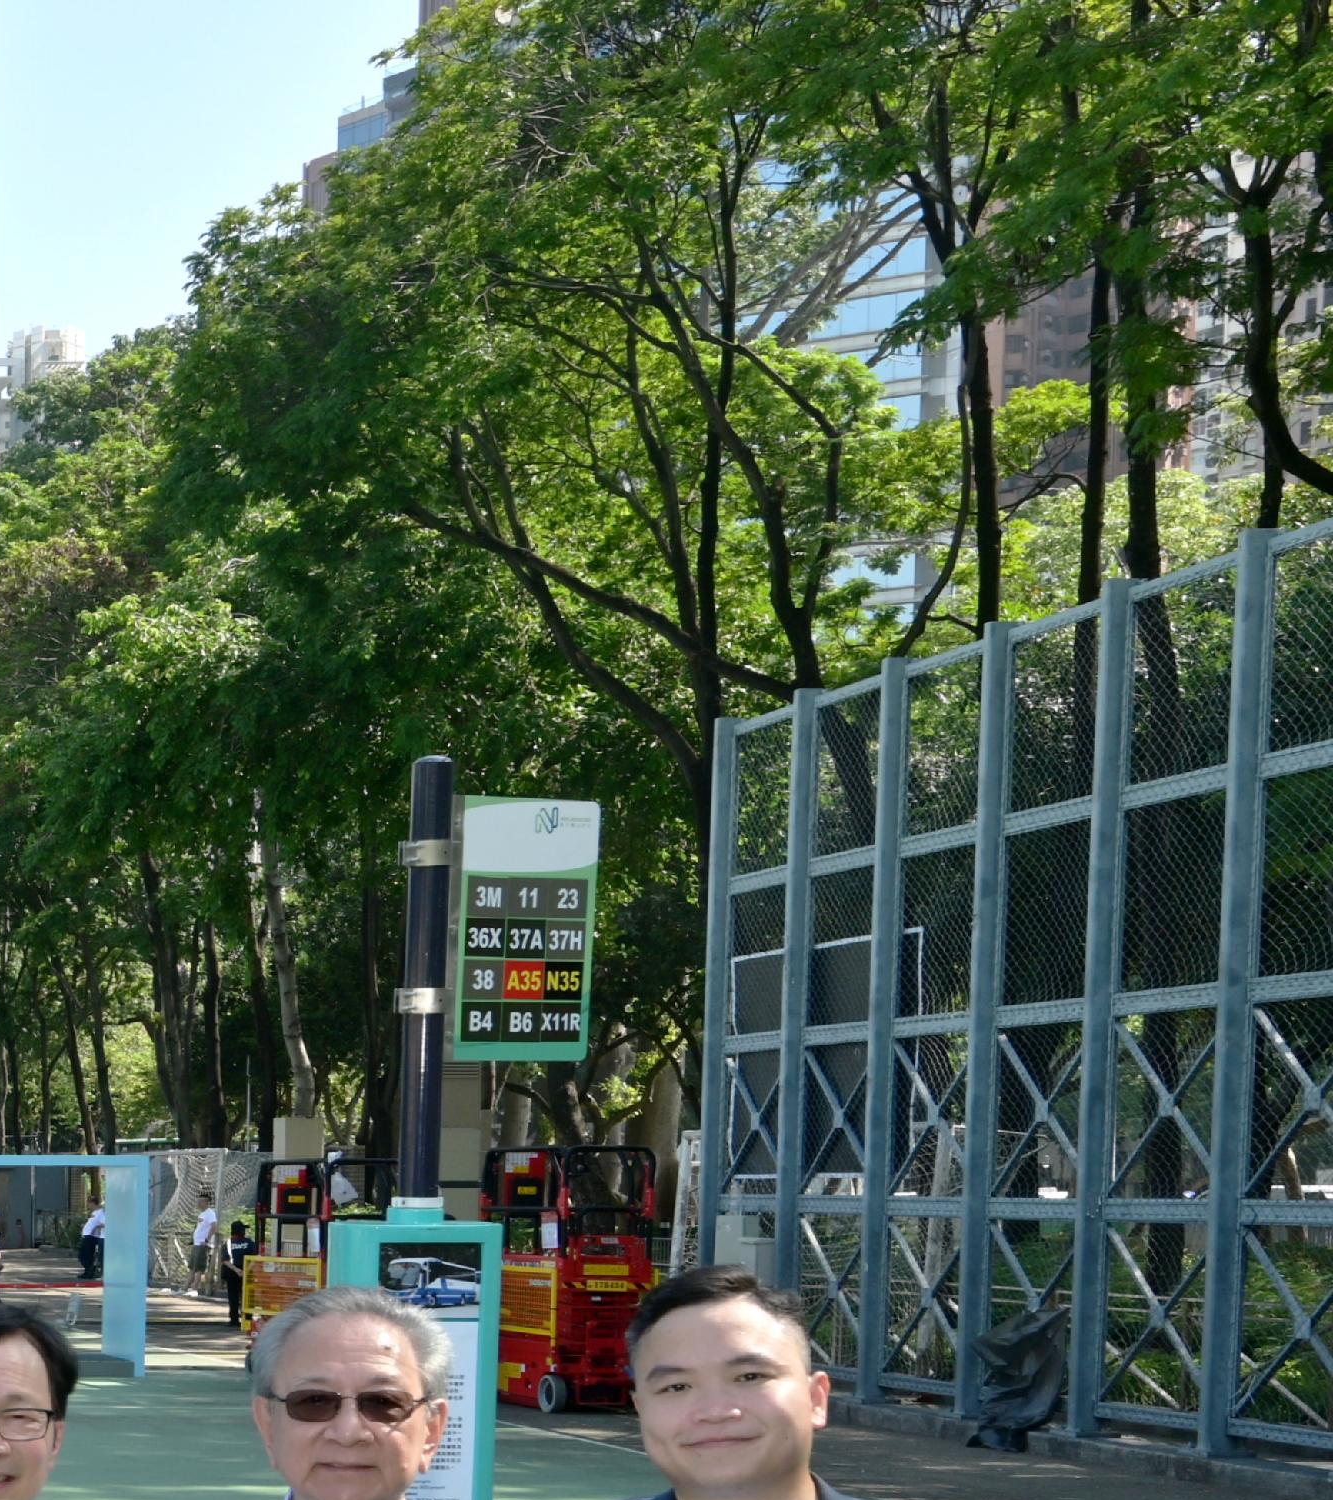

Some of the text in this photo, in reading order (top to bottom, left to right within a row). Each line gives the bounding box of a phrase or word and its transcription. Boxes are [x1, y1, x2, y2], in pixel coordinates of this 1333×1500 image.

[475, 886, 579, 909] 3M 11 23
[468, 927, 582, 951] 36X 37A 37H
[472, 969, 580, 992] 38 A35 N35
[469, 1011, 581, 1033] B4 B6 X11R
